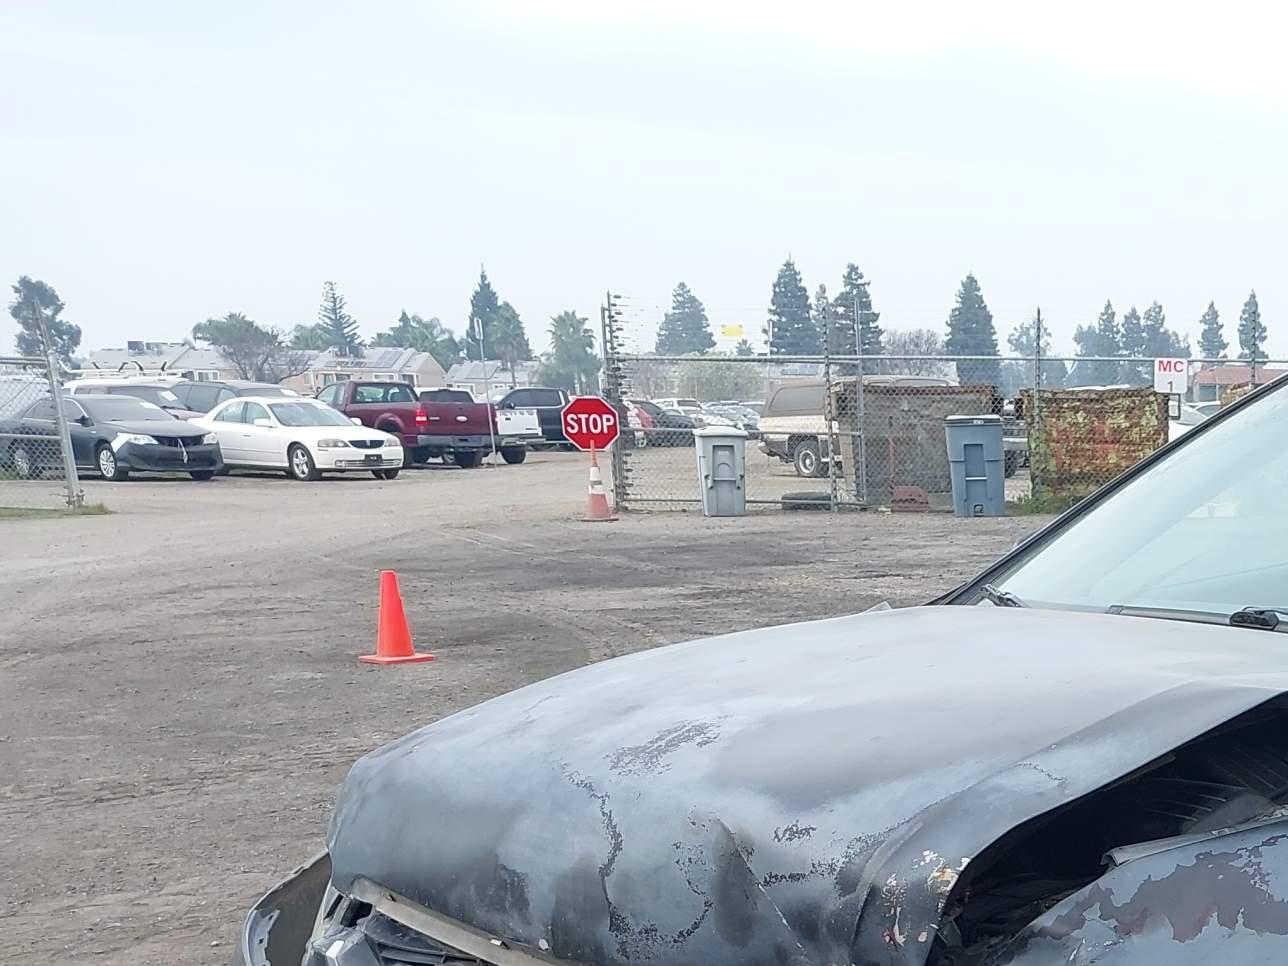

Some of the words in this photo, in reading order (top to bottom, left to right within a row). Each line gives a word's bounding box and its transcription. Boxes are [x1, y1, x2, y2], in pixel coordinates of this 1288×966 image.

[1158, 360, 1184, 373] MC
[1167, 380, 1174, 393] 1
[566, 413, 615, 434] STOP
